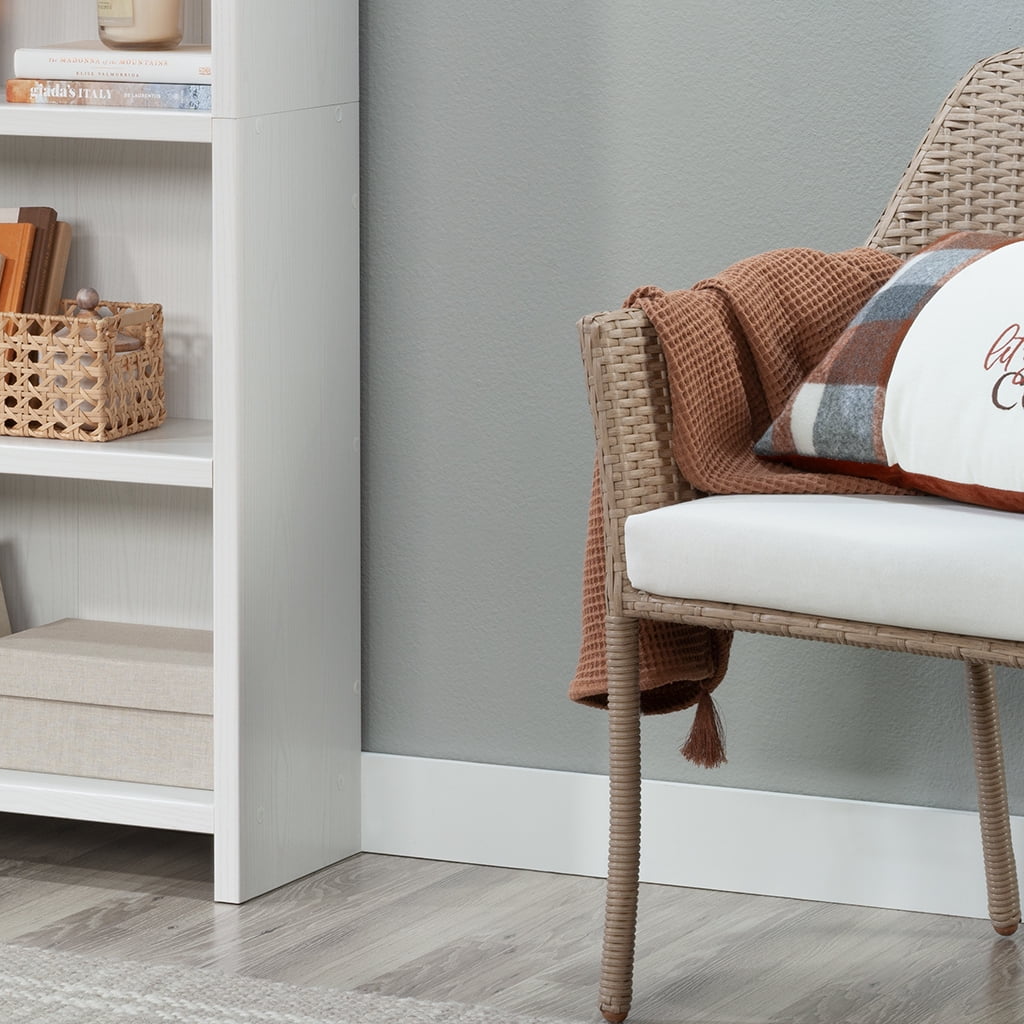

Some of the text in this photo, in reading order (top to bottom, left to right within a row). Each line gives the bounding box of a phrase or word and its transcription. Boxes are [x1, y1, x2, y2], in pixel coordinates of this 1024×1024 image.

[118, 59, 168, 67] MOUNTAINS
[30, 83, 112, 100] giada's ITALY
